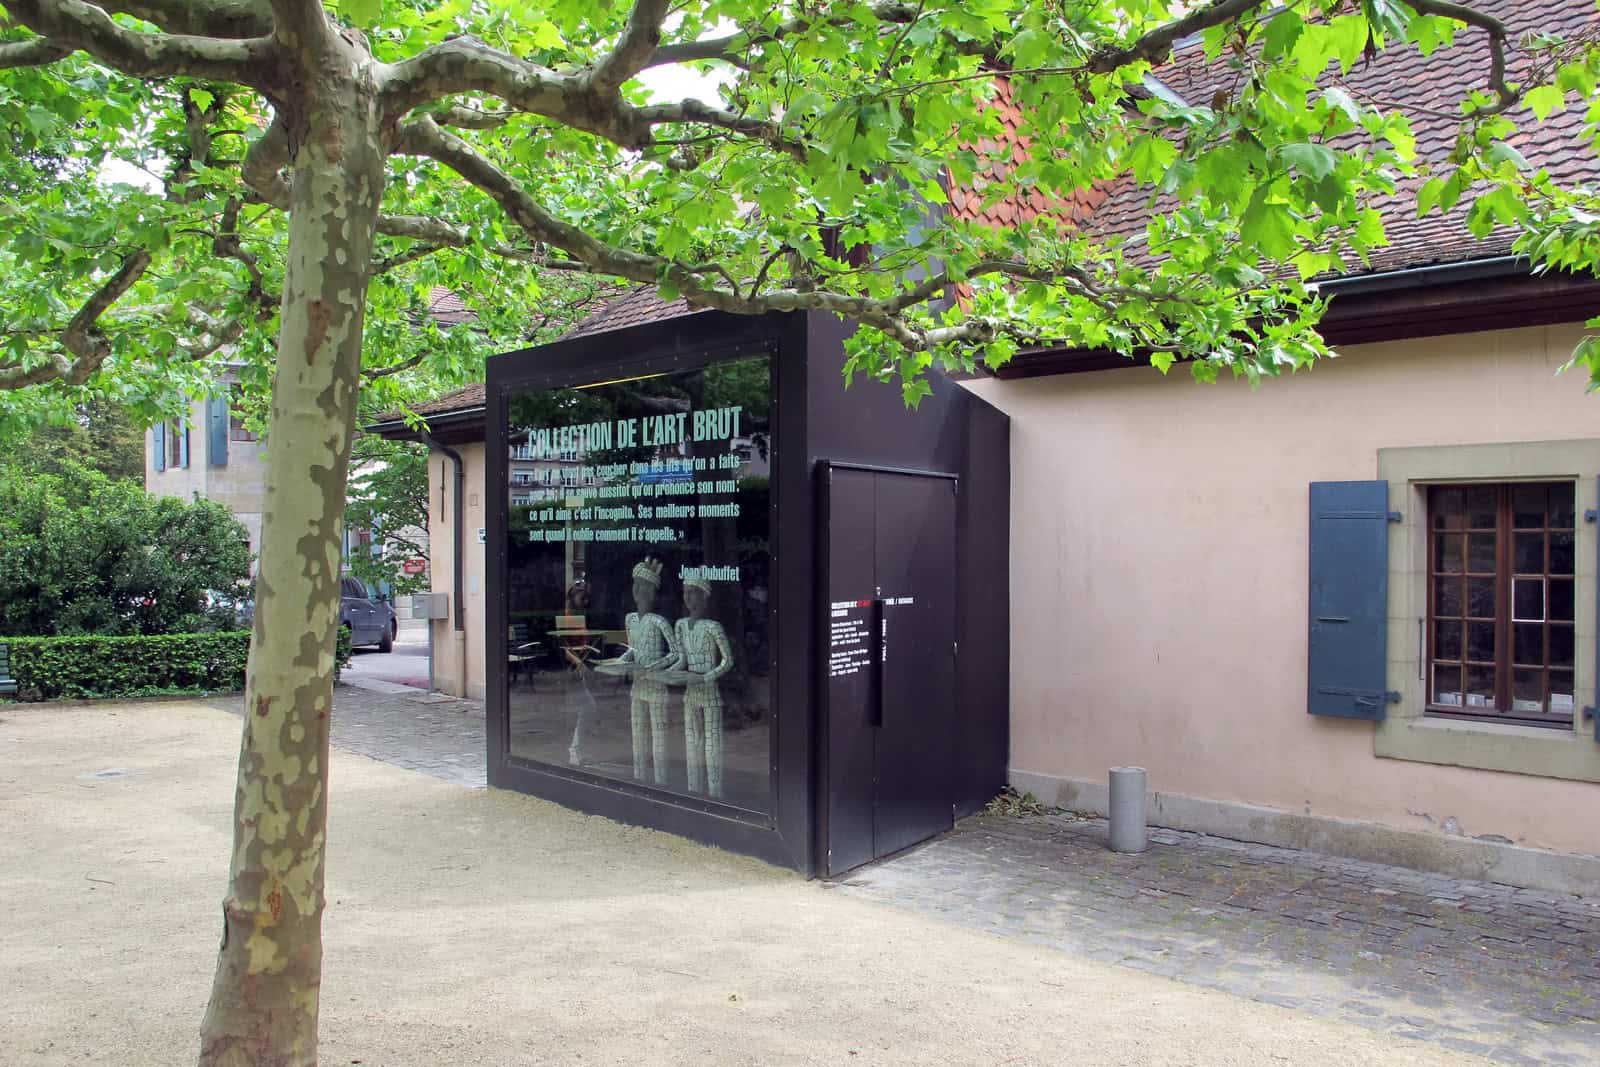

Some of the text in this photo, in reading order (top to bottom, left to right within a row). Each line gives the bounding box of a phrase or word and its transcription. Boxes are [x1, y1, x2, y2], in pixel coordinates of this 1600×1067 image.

[528, 406, 742, 457] COLLECTION DE L'ART BRUT
[709, 456, 716, 470] a
[719, 453, 740, 470] faits
[631, 482, 654, 500] qu'on
[655, 481, 695, 498] prononce
[697, 480, 714, 495] son
[529, 509, 538, 521] ce
[637, 503, 653, 519] Ses
[655, 503, 696, 519] meilleurs
[698, 501, 740, 518] moments
[595, 527, 630, 542] comment
[631, 526, 637, 541] il
[701, 564, 740, 582] Dubuffet
